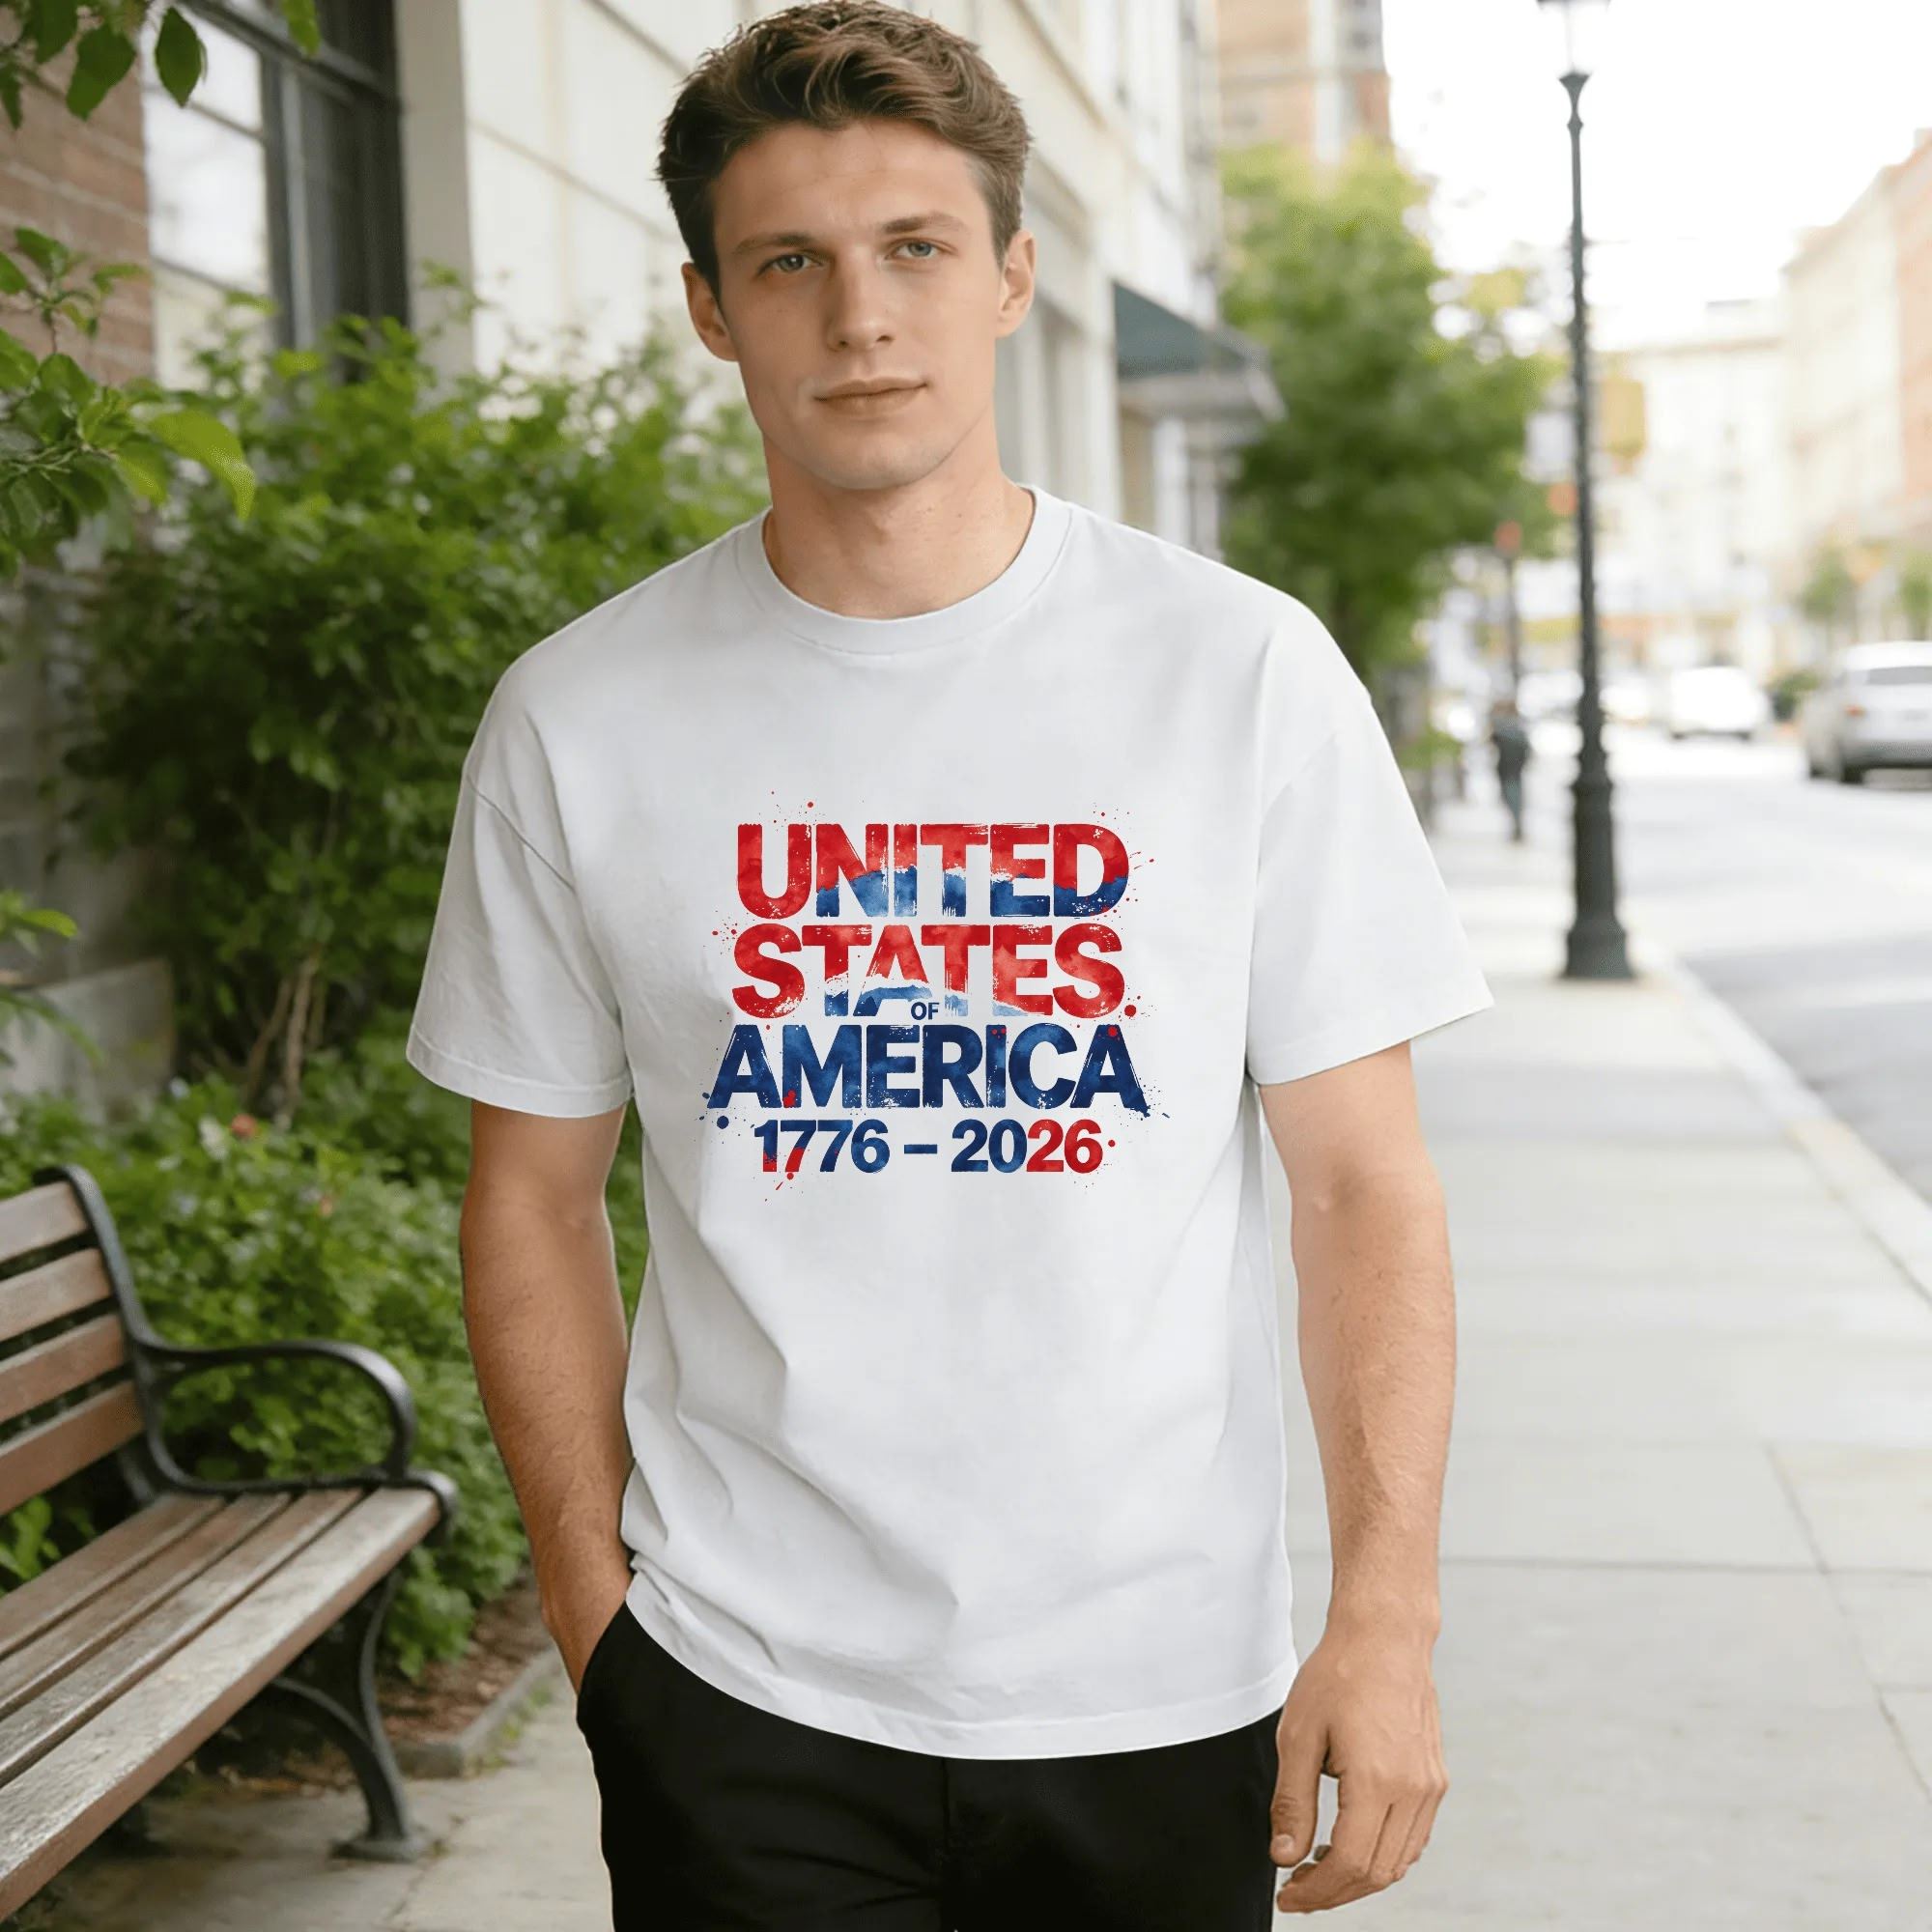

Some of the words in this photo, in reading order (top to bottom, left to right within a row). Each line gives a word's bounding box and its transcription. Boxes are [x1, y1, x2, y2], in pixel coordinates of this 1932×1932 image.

[737, 823, 1129, 919] UNITED
[732, 923, 1125, 1019] STATES
[910, 1001, 940, 1021] OF
[706, 1023, 1148, 1109] AMERICA
[753, 1119, 891, 1174] 1776
[951, 1119, 1104, 1174] 2026
